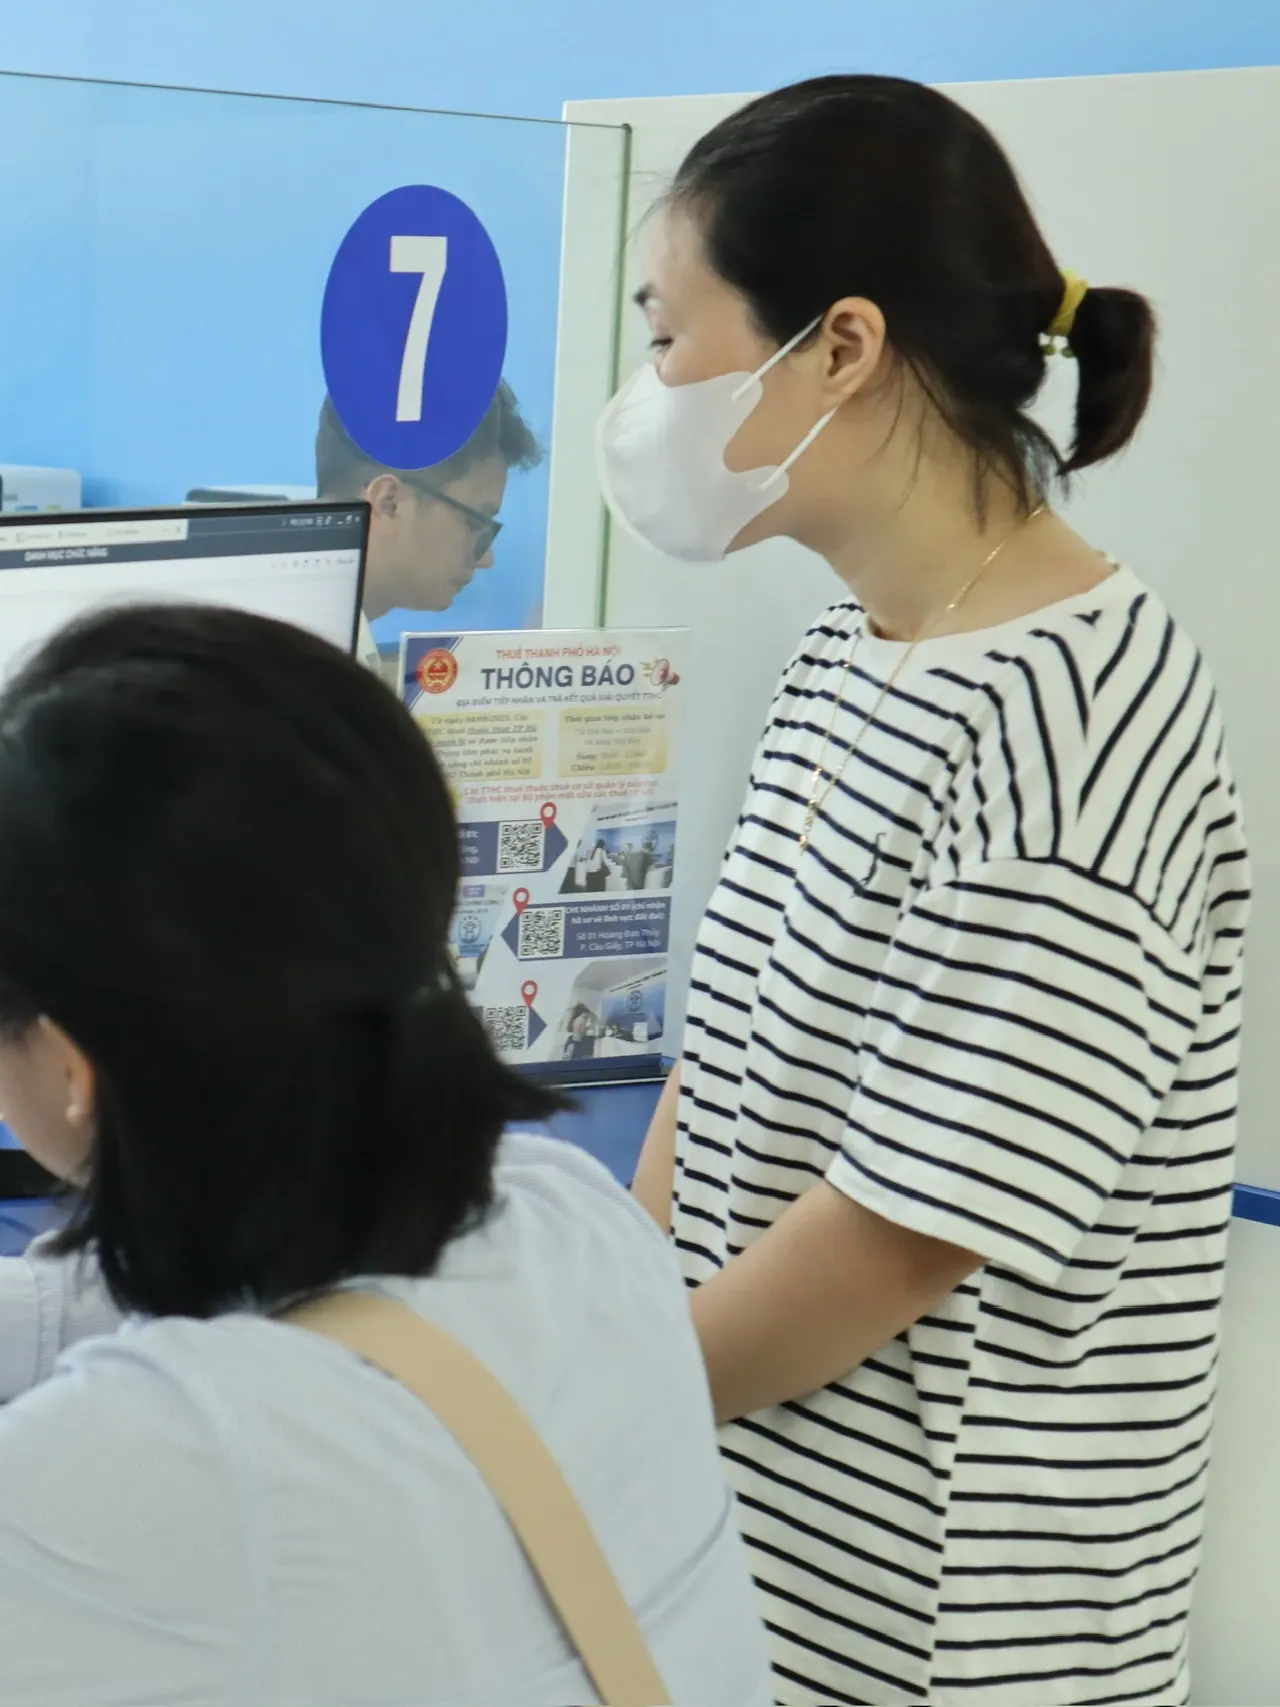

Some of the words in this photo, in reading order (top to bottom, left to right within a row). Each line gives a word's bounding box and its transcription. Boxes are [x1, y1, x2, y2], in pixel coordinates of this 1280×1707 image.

[389, 235, 448, 422] 7
[481, 661, 573, 690] THÔNG
[580, 659, 635, 687] BÁO
